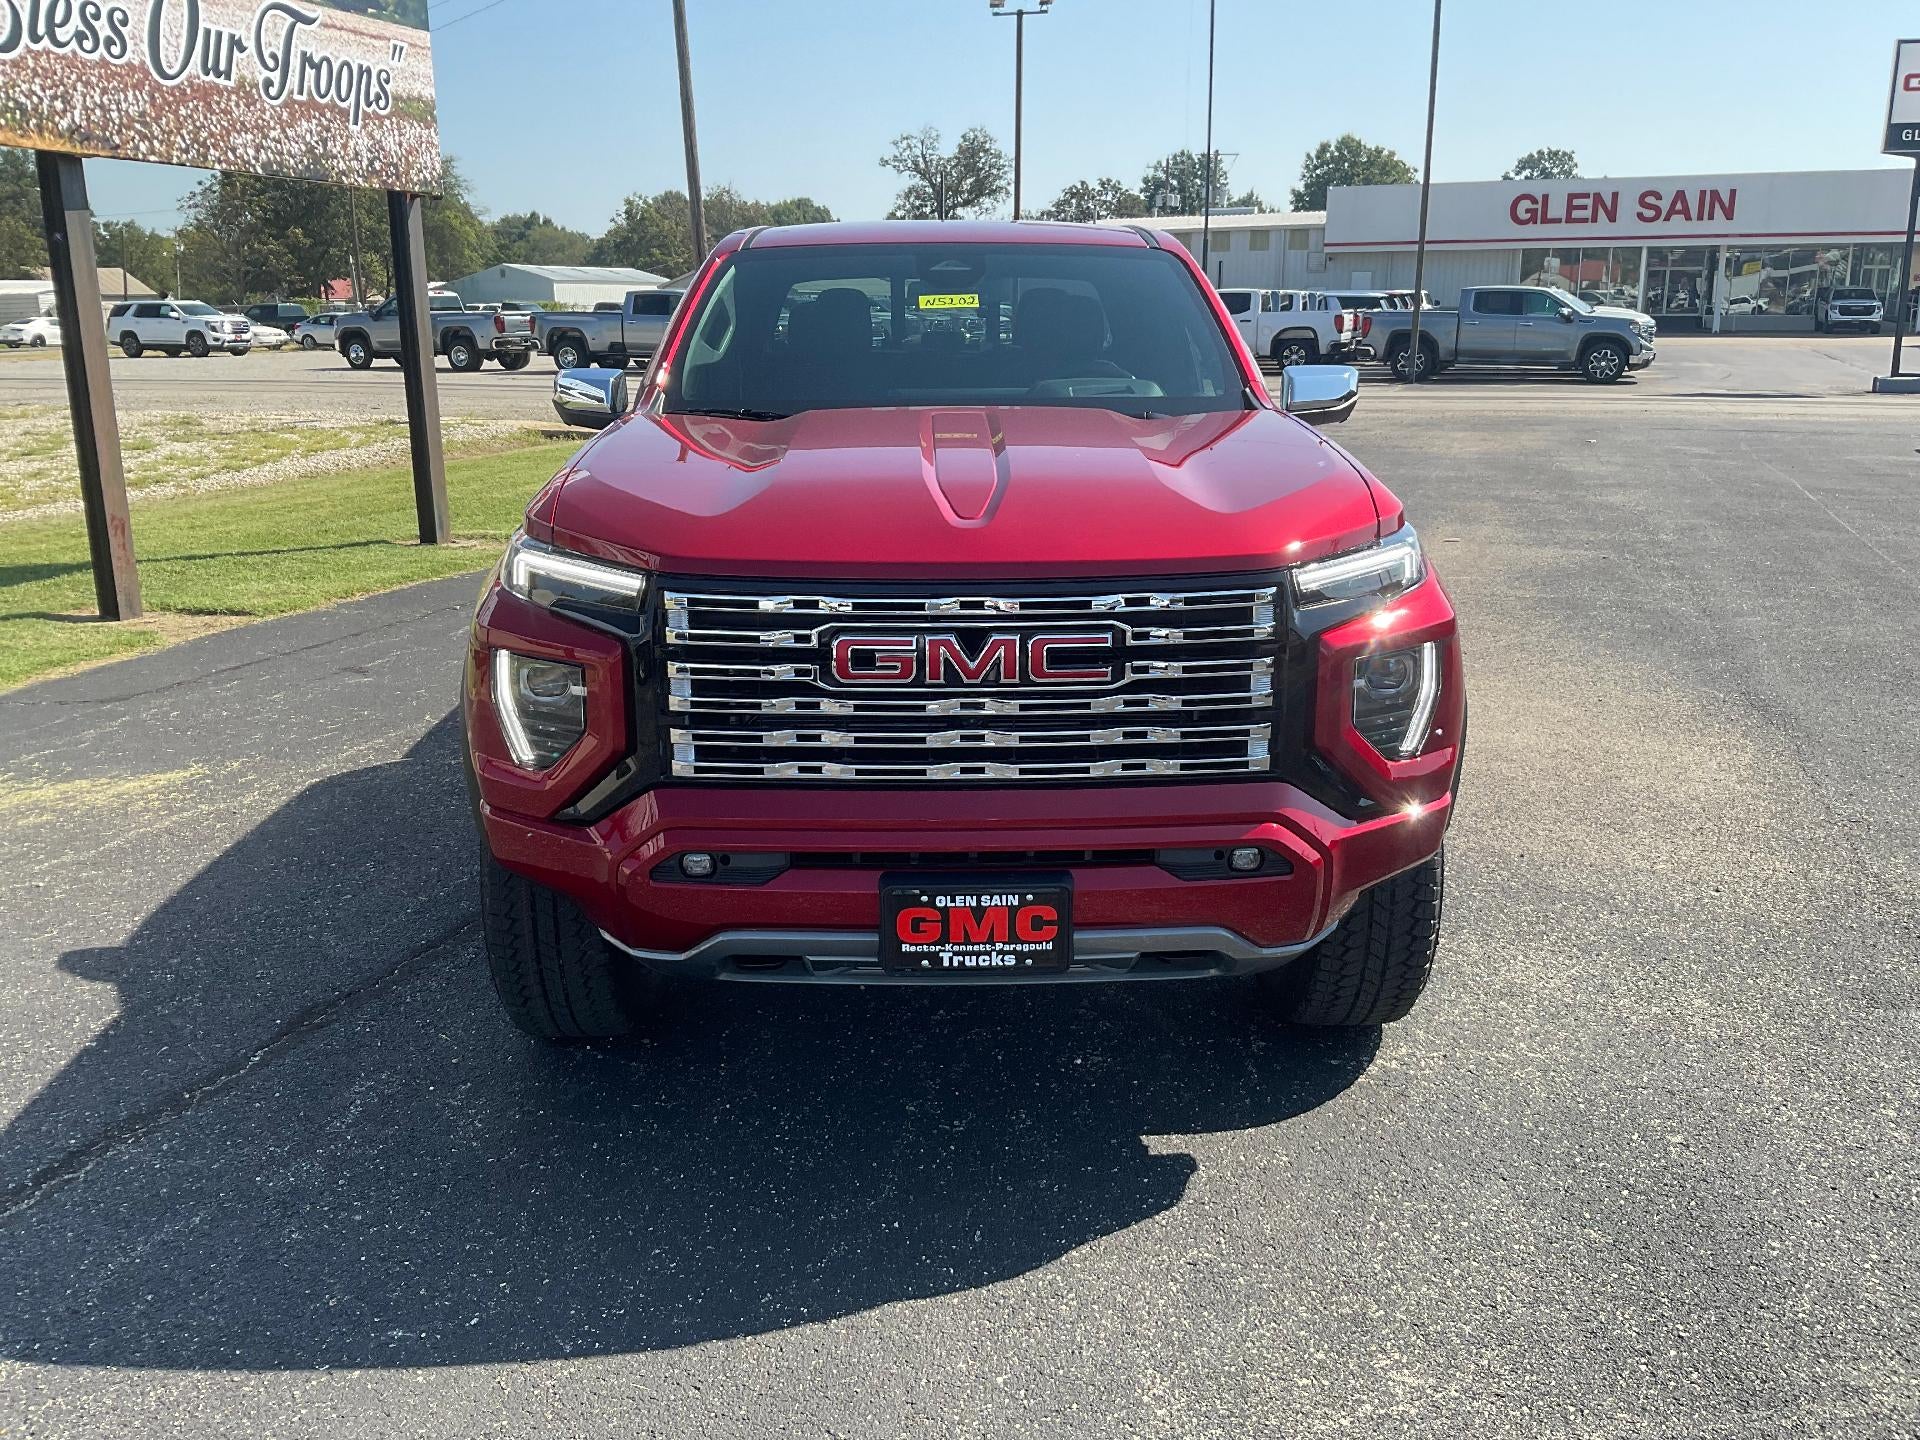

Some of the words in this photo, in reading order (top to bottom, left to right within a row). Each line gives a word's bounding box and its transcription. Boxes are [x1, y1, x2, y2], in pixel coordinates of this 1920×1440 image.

[147, 0, 248, 82] Our
[1509, 191, 1619, 225] GLEN
[1636, 188, 1737, 223] SAIN
[832, 632, 1113, 684] GMC
[935, 896, 977, 907] GLEN
[981, 894, 1019, 906] SAIN
[896, 905, 1058, 943] GMC
[939, 951, 1017, 967] Trucks
